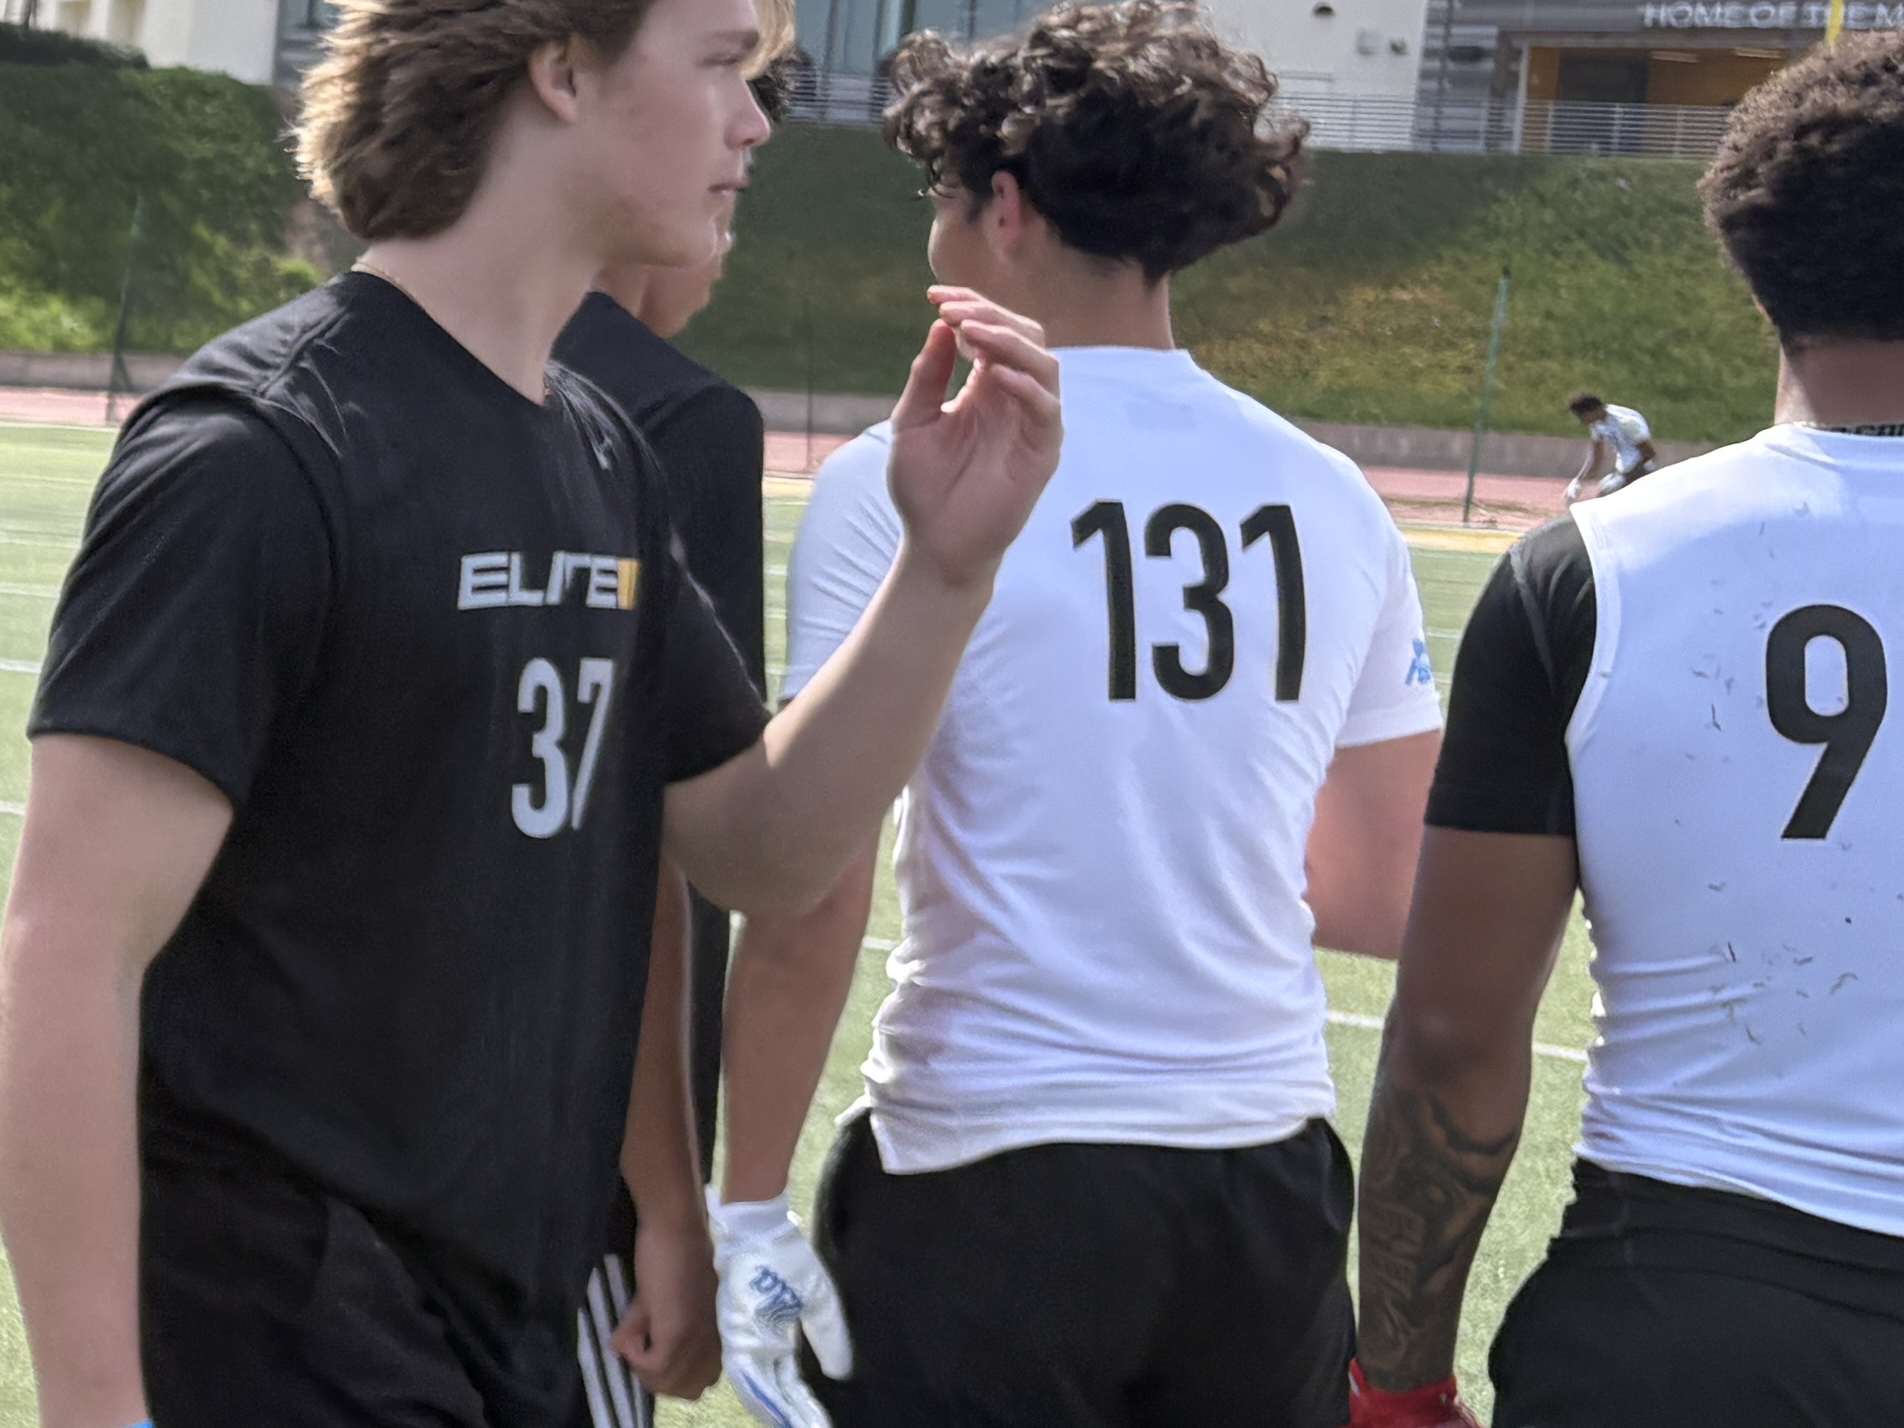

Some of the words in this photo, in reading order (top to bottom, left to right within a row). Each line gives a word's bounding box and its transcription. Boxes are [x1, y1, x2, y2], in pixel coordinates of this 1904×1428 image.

[1642, 1, 1743, 28] HOME
[1749, 1, 1796, 28] OF
[1070, 500, 1307, 703] 131
[511, 656, 615, 840] 37
[1764, 603, 1888, 841] 9
